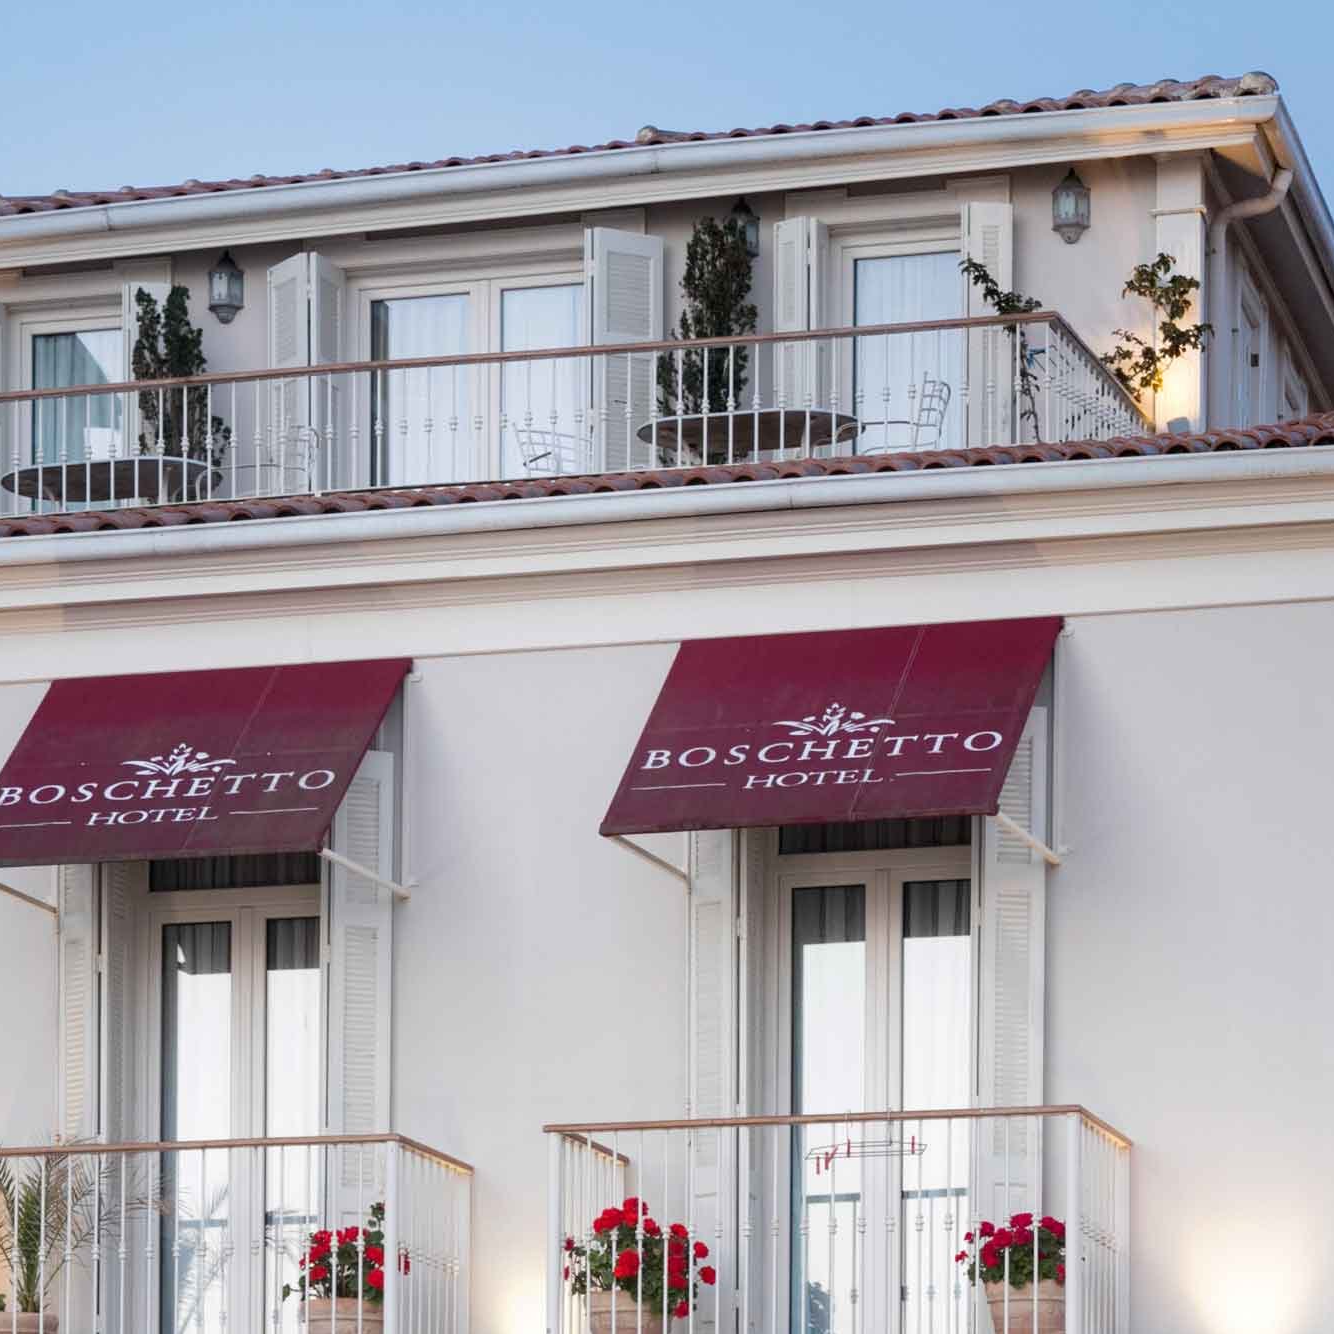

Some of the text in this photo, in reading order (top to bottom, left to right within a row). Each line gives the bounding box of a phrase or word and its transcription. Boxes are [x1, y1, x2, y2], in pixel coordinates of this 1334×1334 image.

[642, 732, 1002, 769] BOSCHETTO
[744, 769, 883, 788] HOTEL
[87, 807, 217, 825] HOTEL
